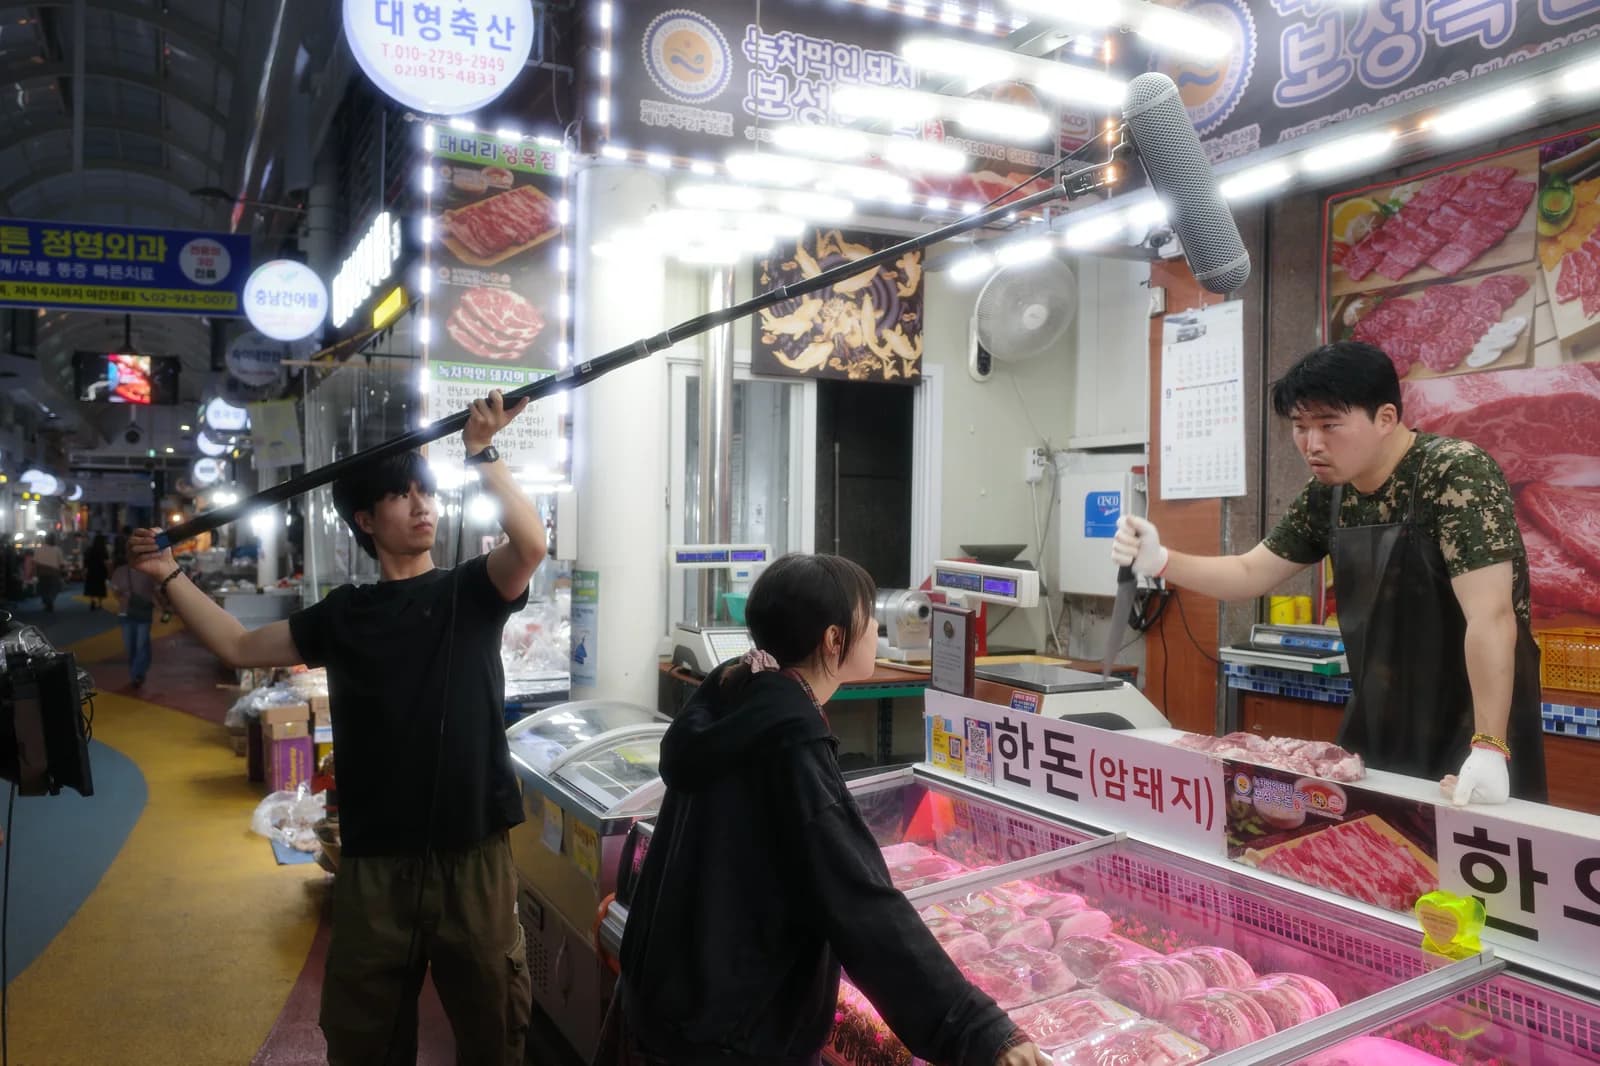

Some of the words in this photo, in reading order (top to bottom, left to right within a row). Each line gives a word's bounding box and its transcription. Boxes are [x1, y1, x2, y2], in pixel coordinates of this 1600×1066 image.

[375, 0, 517, 52] 대형축산
[381, 43, 505, 72] T.010-2739-2949
[743, 24, 862, 85] 녹차먹인
[1056, 112, 1089, 127] ACCP
[438, 133, 498, 161] 대머리
[501, 142, 558, 170] 정육점
[41, 229, 168, 263] 정형외과
[438, 364, 486, 381] 녹차먹인
[994, 716, 1083, 802] 한돈
[1089, 748, 1214, 831] (암돼지)
